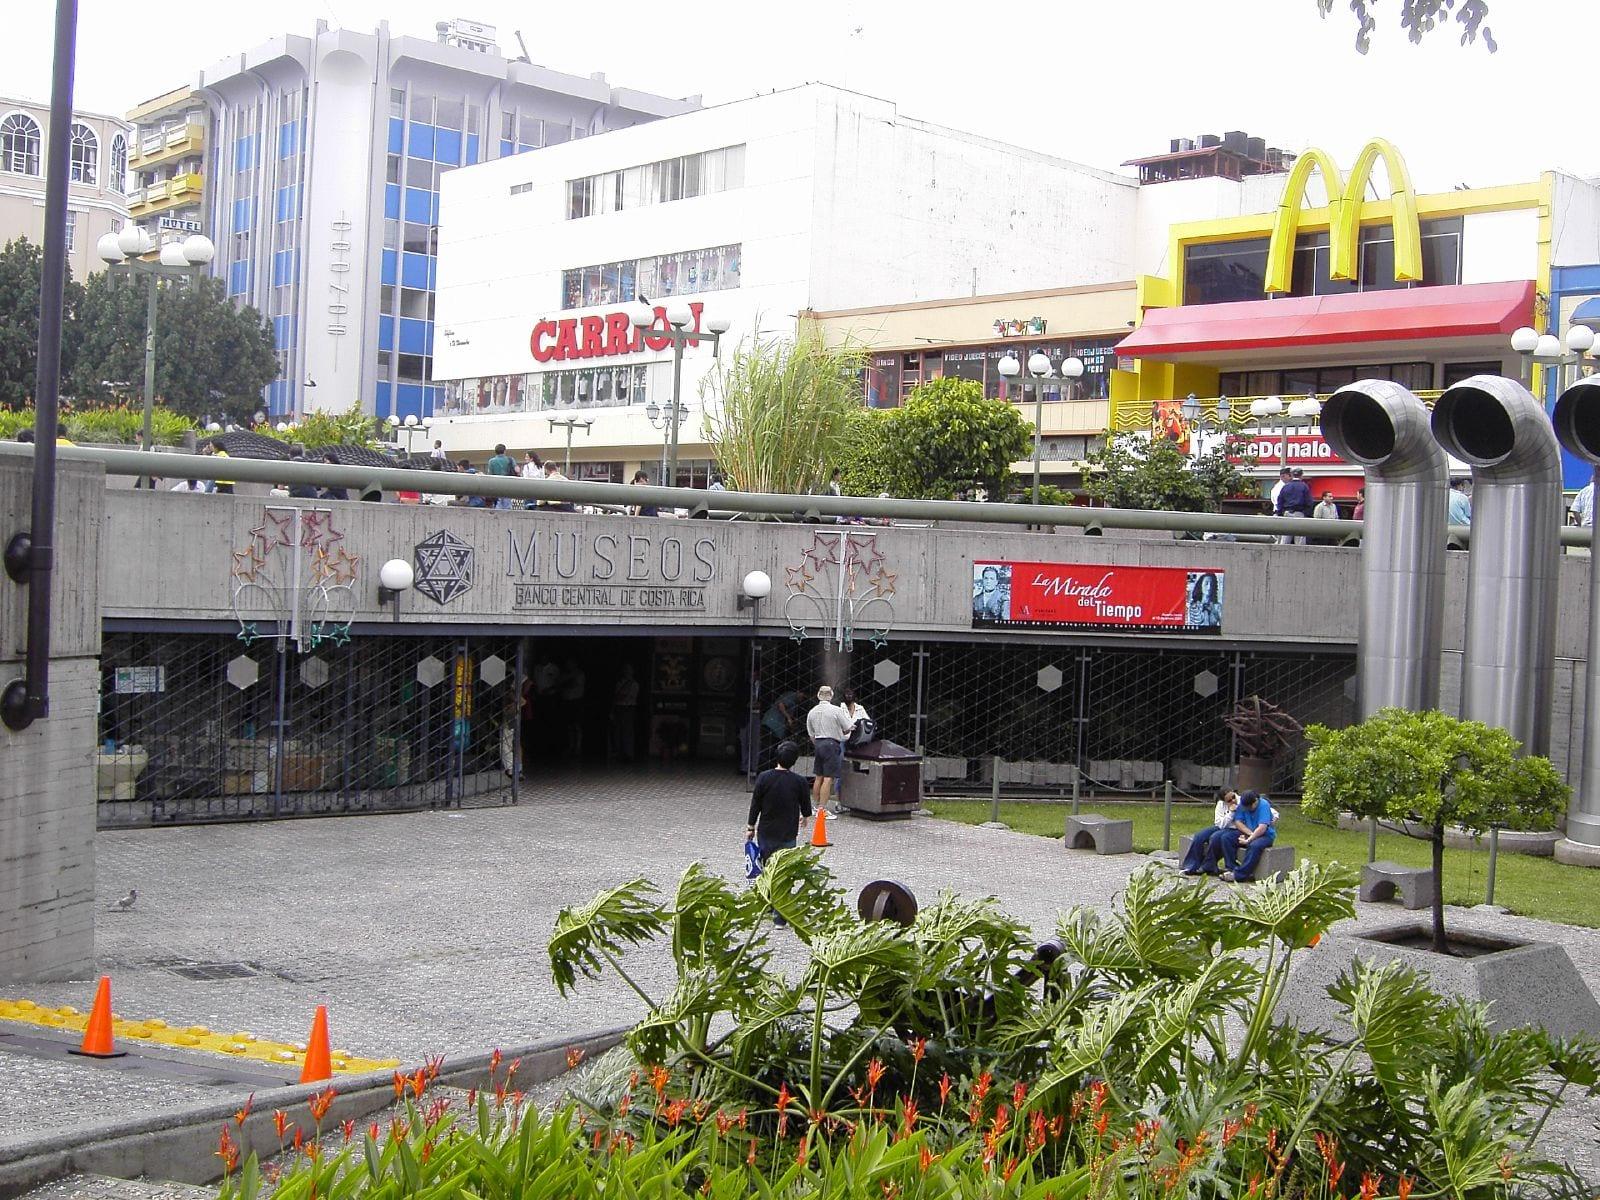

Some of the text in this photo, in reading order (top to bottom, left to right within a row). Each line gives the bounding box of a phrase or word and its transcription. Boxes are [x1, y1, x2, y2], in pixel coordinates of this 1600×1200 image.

[162, 218, 201, 231] HOTEL
[1231, 440, 1340, 458] cDonald
[506, 528, 716, 582] MUSEOS
[516, 585, 705, 606] BANCO CENTRAL DE COSTA RICA
[1031, 571, 1114, 598] La Mirada
[1078, 597, 1142, 622] del Tiempo
